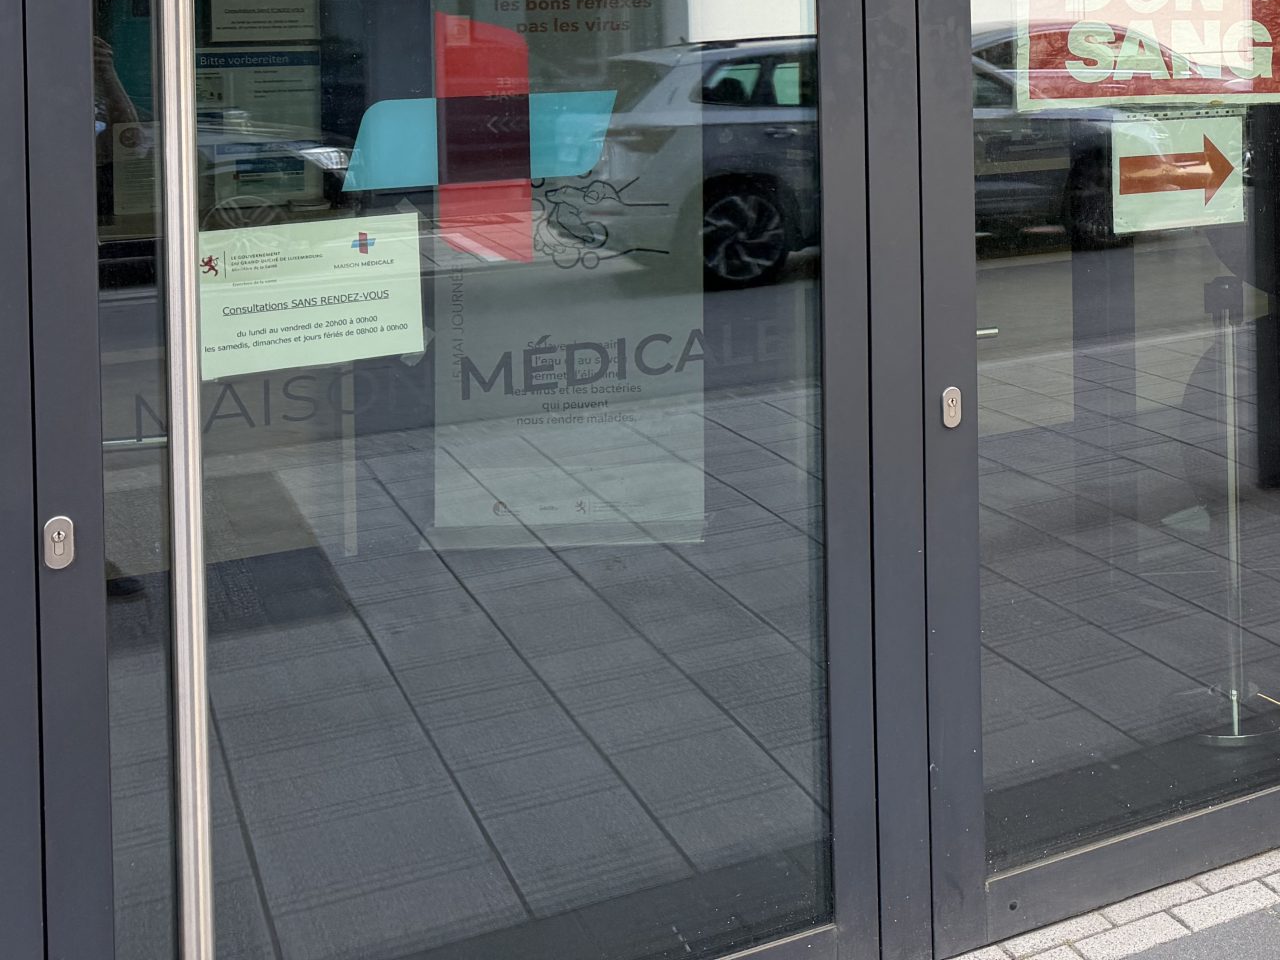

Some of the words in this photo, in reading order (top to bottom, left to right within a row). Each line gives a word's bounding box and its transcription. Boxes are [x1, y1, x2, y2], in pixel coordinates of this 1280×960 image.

[516, 21, 548, 34] pas
[553, 18, 580, 33] les
[585, 17, 630, 32] virus
[1066, 19, 1273, 84] SANG
[200, 56, 226, 65] Bitte
[222, 301, 288, 316] Consultations
[291, 296, 317, 309] SANS
[320, 290, 389, 305] RENDEZ-VOUS
[249, 328, 267, 336] lundi
[280, 322, 312, 332] vendredi
[325, 319, 347, 328] 20h00
[349, 317, 354, 325] à
[355, 315, 378, 324] 00h00
[217, 342, 250, 352] samedis,
[252, 337, 292, 347] dimanches
[303, 334, 322, 343] jours
[323, 330, 343, 339] fériés
[345, 329, 354, 337] de
[356, 326, 378, 336] 08h00
[379, 325, 385, 333] à
[386, 323, 408, 332] 00h00
[572, 384, 588, 394] les
[590, 383, 642, 394] bactéries
[542, 400, 560, 412] qui
[562, 399, 609, 411] peuvent
[516, 416, 544, 425] nous
[547, 414, 584, 424] rendre
